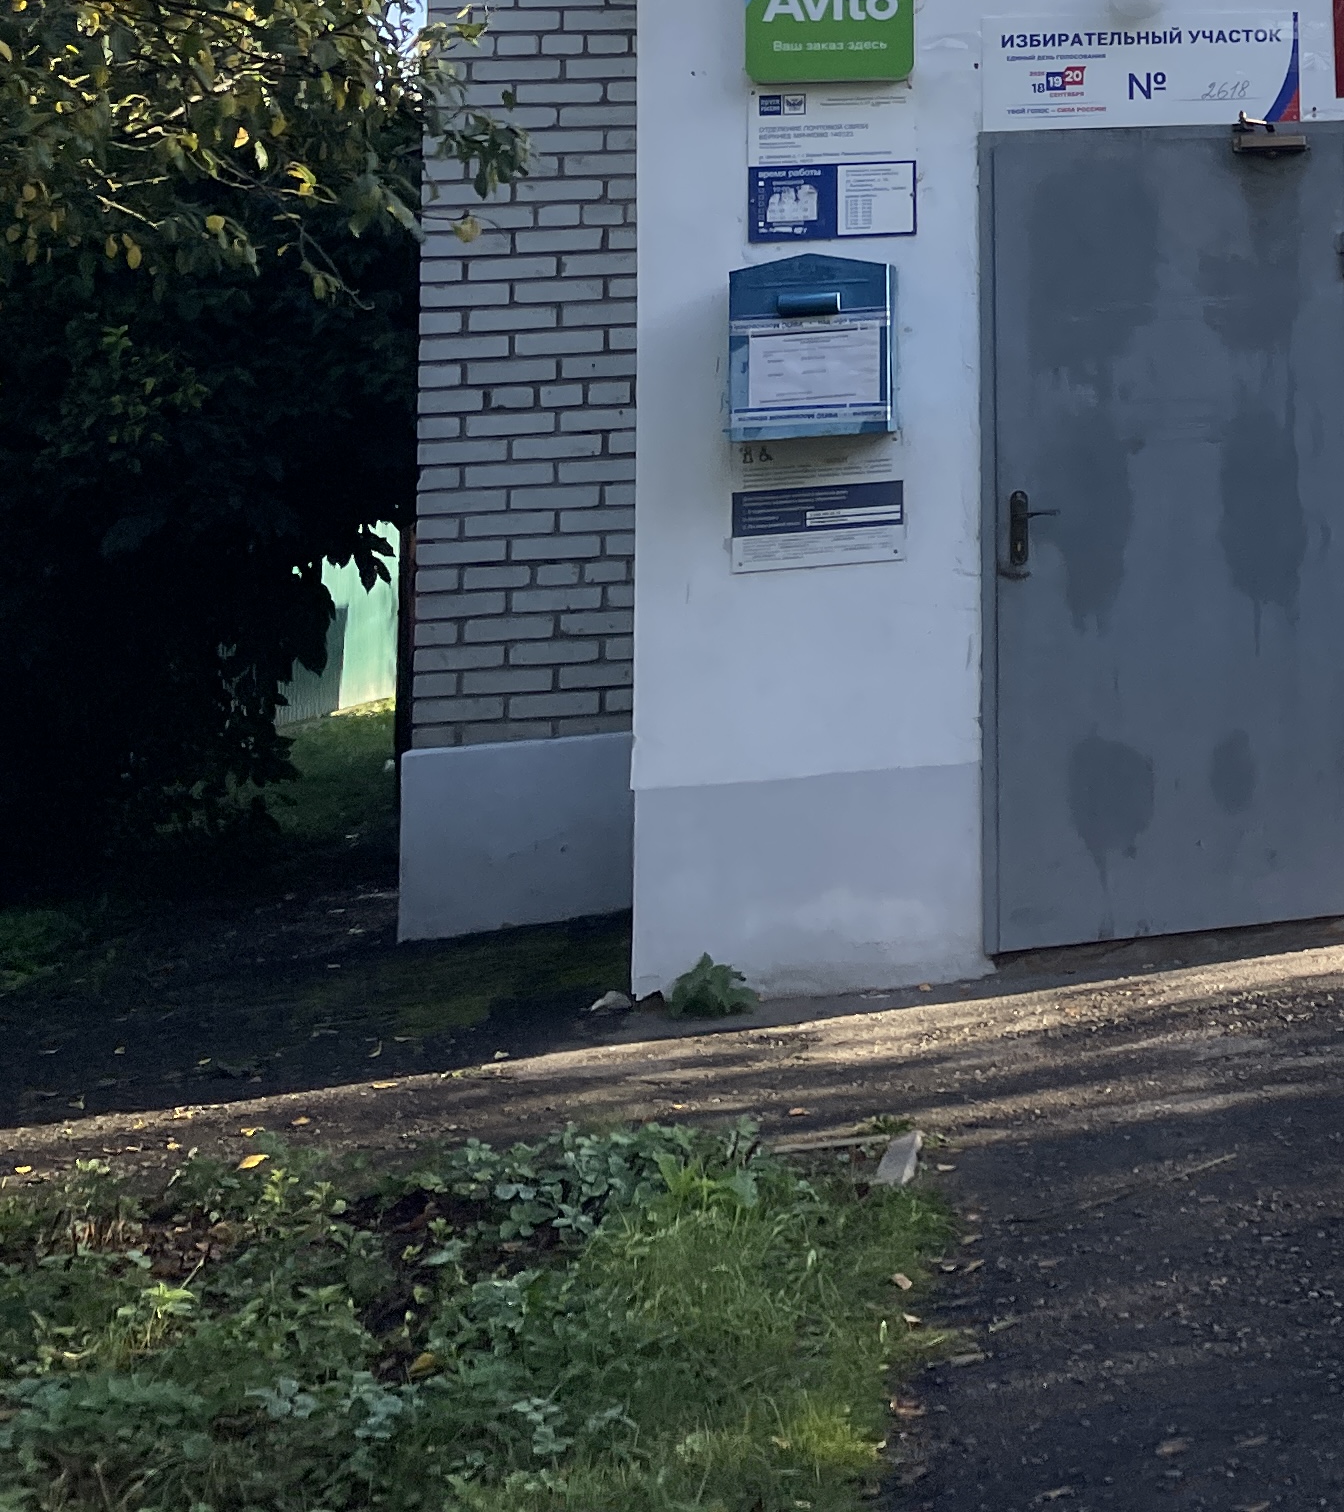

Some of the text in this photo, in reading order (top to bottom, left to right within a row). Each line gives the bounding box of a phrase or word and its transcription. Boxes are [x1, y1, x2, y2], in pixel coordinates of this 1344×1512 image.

[1000, 26, 1283, 49] ИЗБИРАТЕЛЬНЫЙ УЧАСТОК
[772, 40, 888, 52] Ваш заказ здесь
[1006, 54, 1035, 62] ЕДИНЫЙ
[1055, 53, 1107, 61] ГОЛОСОВАНИЯ
[1031, 70, 1083, 94] 18 19 20
[1200, 80, 1250, 101] 2618
[1006, 107, 1026, 115] ТВОЙ
[758, 168, 822, 179] время работы
